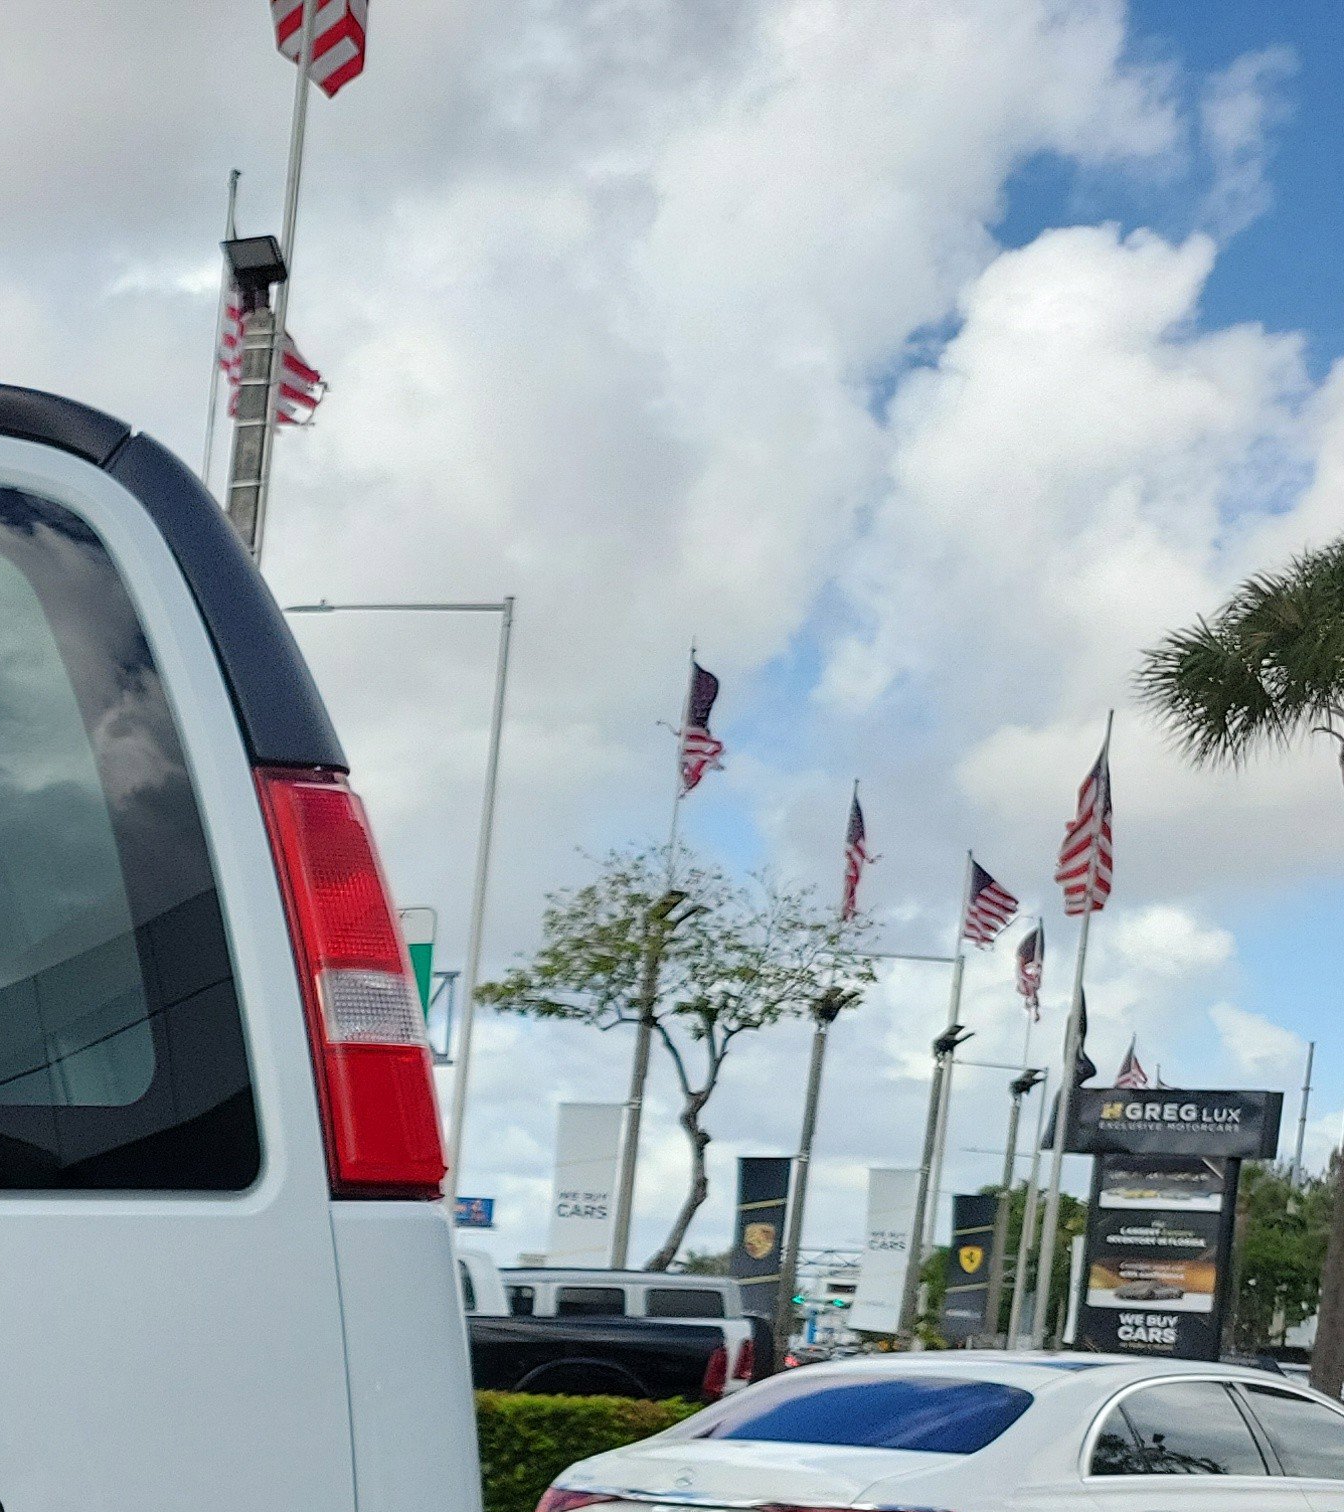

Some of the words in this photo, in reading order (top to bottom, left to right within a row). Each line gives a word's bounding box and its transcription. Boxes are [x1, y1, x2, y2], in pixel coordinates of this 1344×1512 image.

[1201, 1107, 1242, 1124] LUX
[1098, 1121, 1163, 1132] EXCLUSIVE
[1166, 1123, 1241, 1133] MOTORCARS
[556, 1203, 608, 1219] CARS
[1119, 1313, 1145, 1326] WE
[1146, 1314, 1179, 1328] BUY
[1117, 1325, 1177, 1343] CARS
